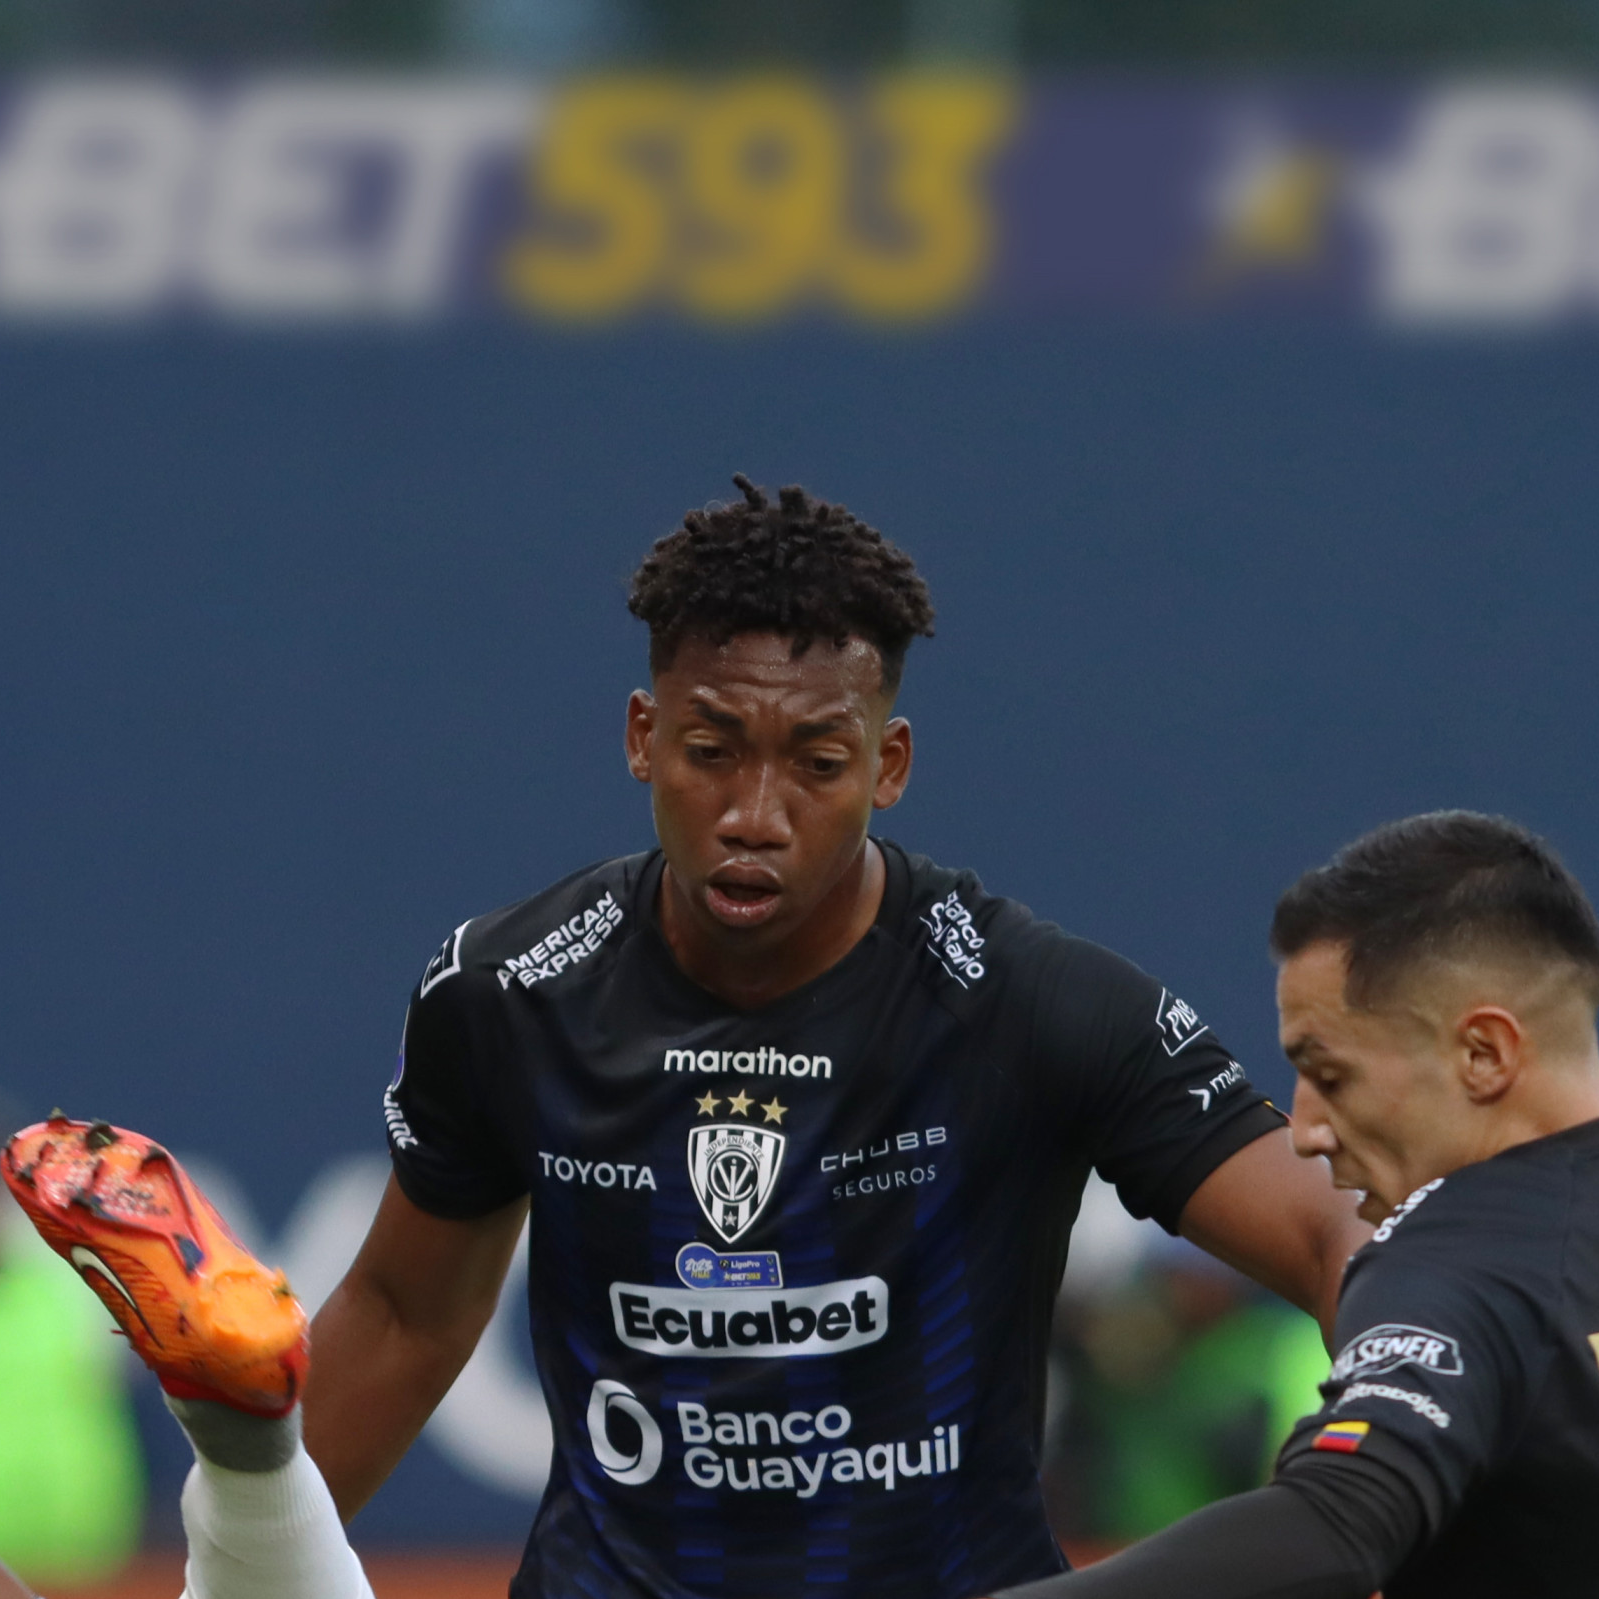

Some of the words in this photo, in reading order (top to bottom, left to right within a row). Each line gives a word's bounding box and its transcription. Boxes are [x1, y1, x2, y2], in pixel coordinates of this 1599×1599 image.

[496, 890, 614, 990] AMERICAN
[516, 902, 624, 990] EXPRESS
[663, 1046, 833, 1078] marathon
[538, 1151, 657, 1192] TOYOTA
[820, 1126, 947, 1173] CHUBB
[832, 1164, 937, 1200] SEGUROS
[618, 1290, 877, 1349] Ecuabet
[677, 1401, 852, 1446] Banco
[683, 1424, 960, 1499] Guayaquil
